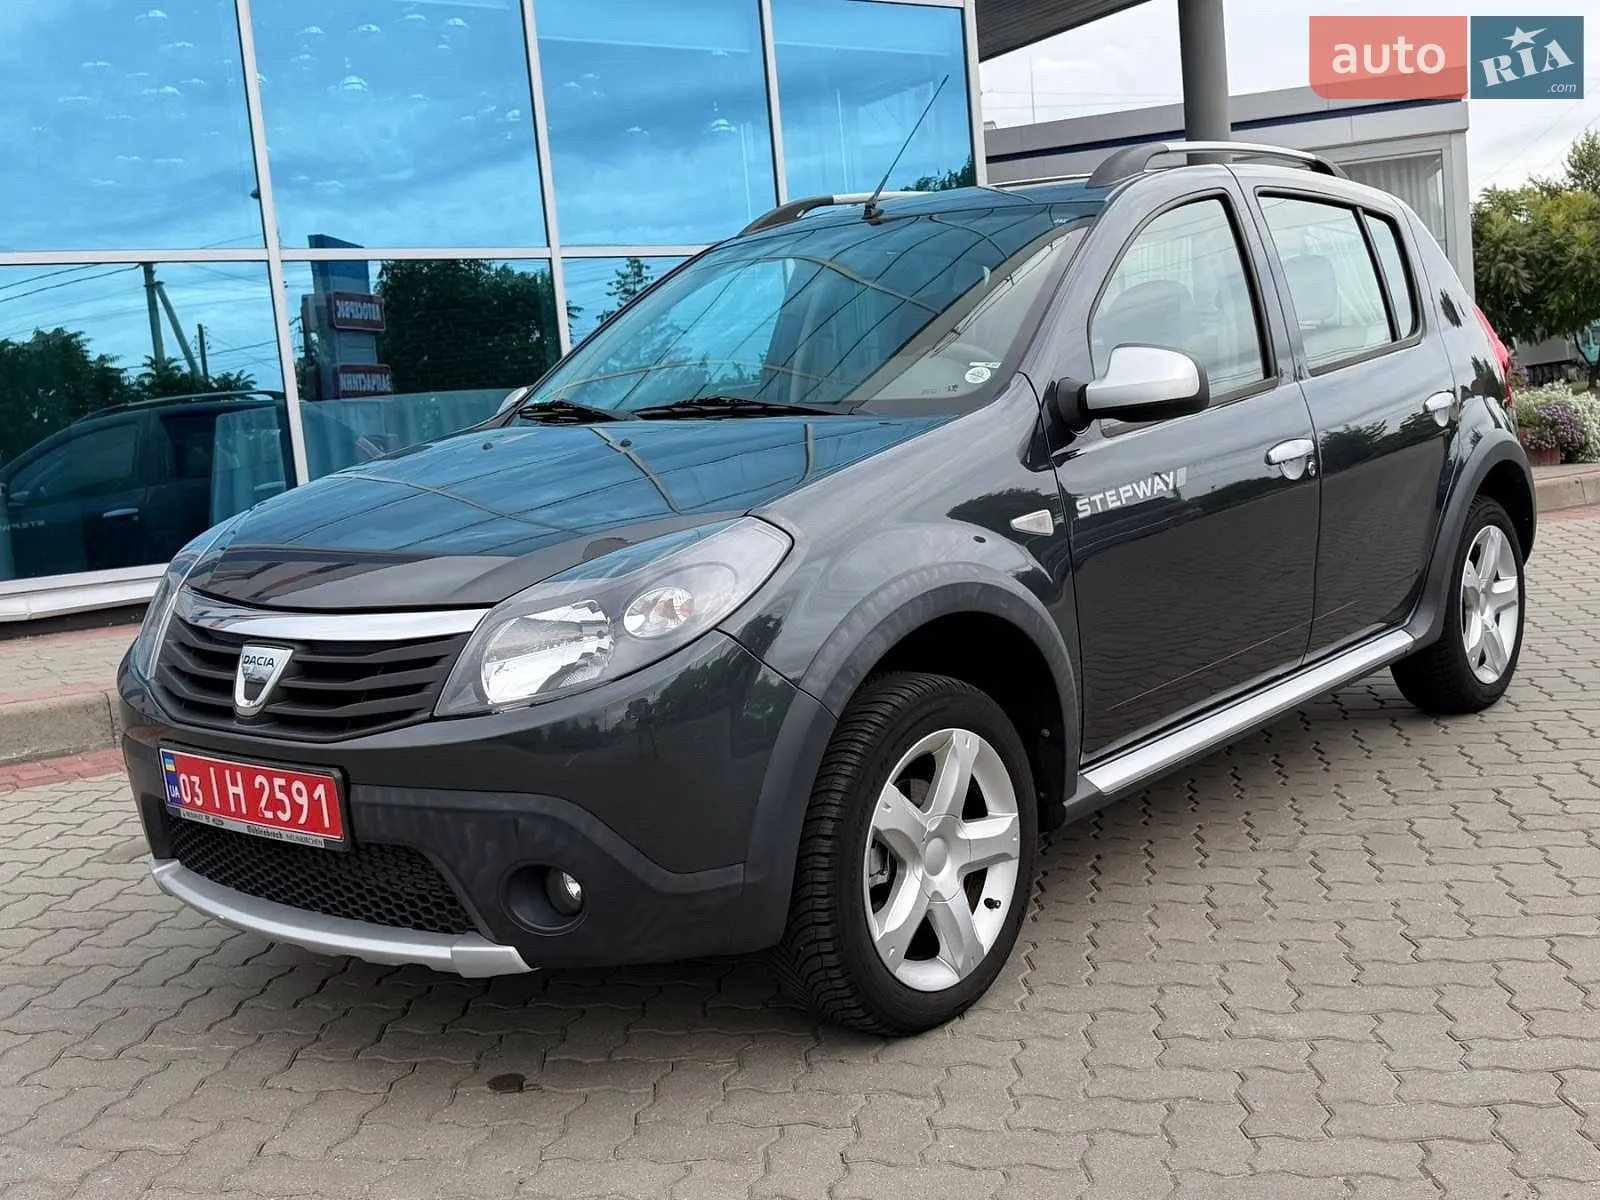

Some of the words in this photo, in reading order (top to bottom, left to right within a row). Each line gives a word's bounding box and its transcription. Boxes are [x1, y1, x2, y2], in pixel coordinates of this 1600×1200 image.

[1076, 471, 1174, 519] STEPWAY
[243, 655, 274, 668] DACIA
[169, 785, 181, 799] UA
[179, 773, 204, 807] 03
[254, 775, 330, 829] 2591
